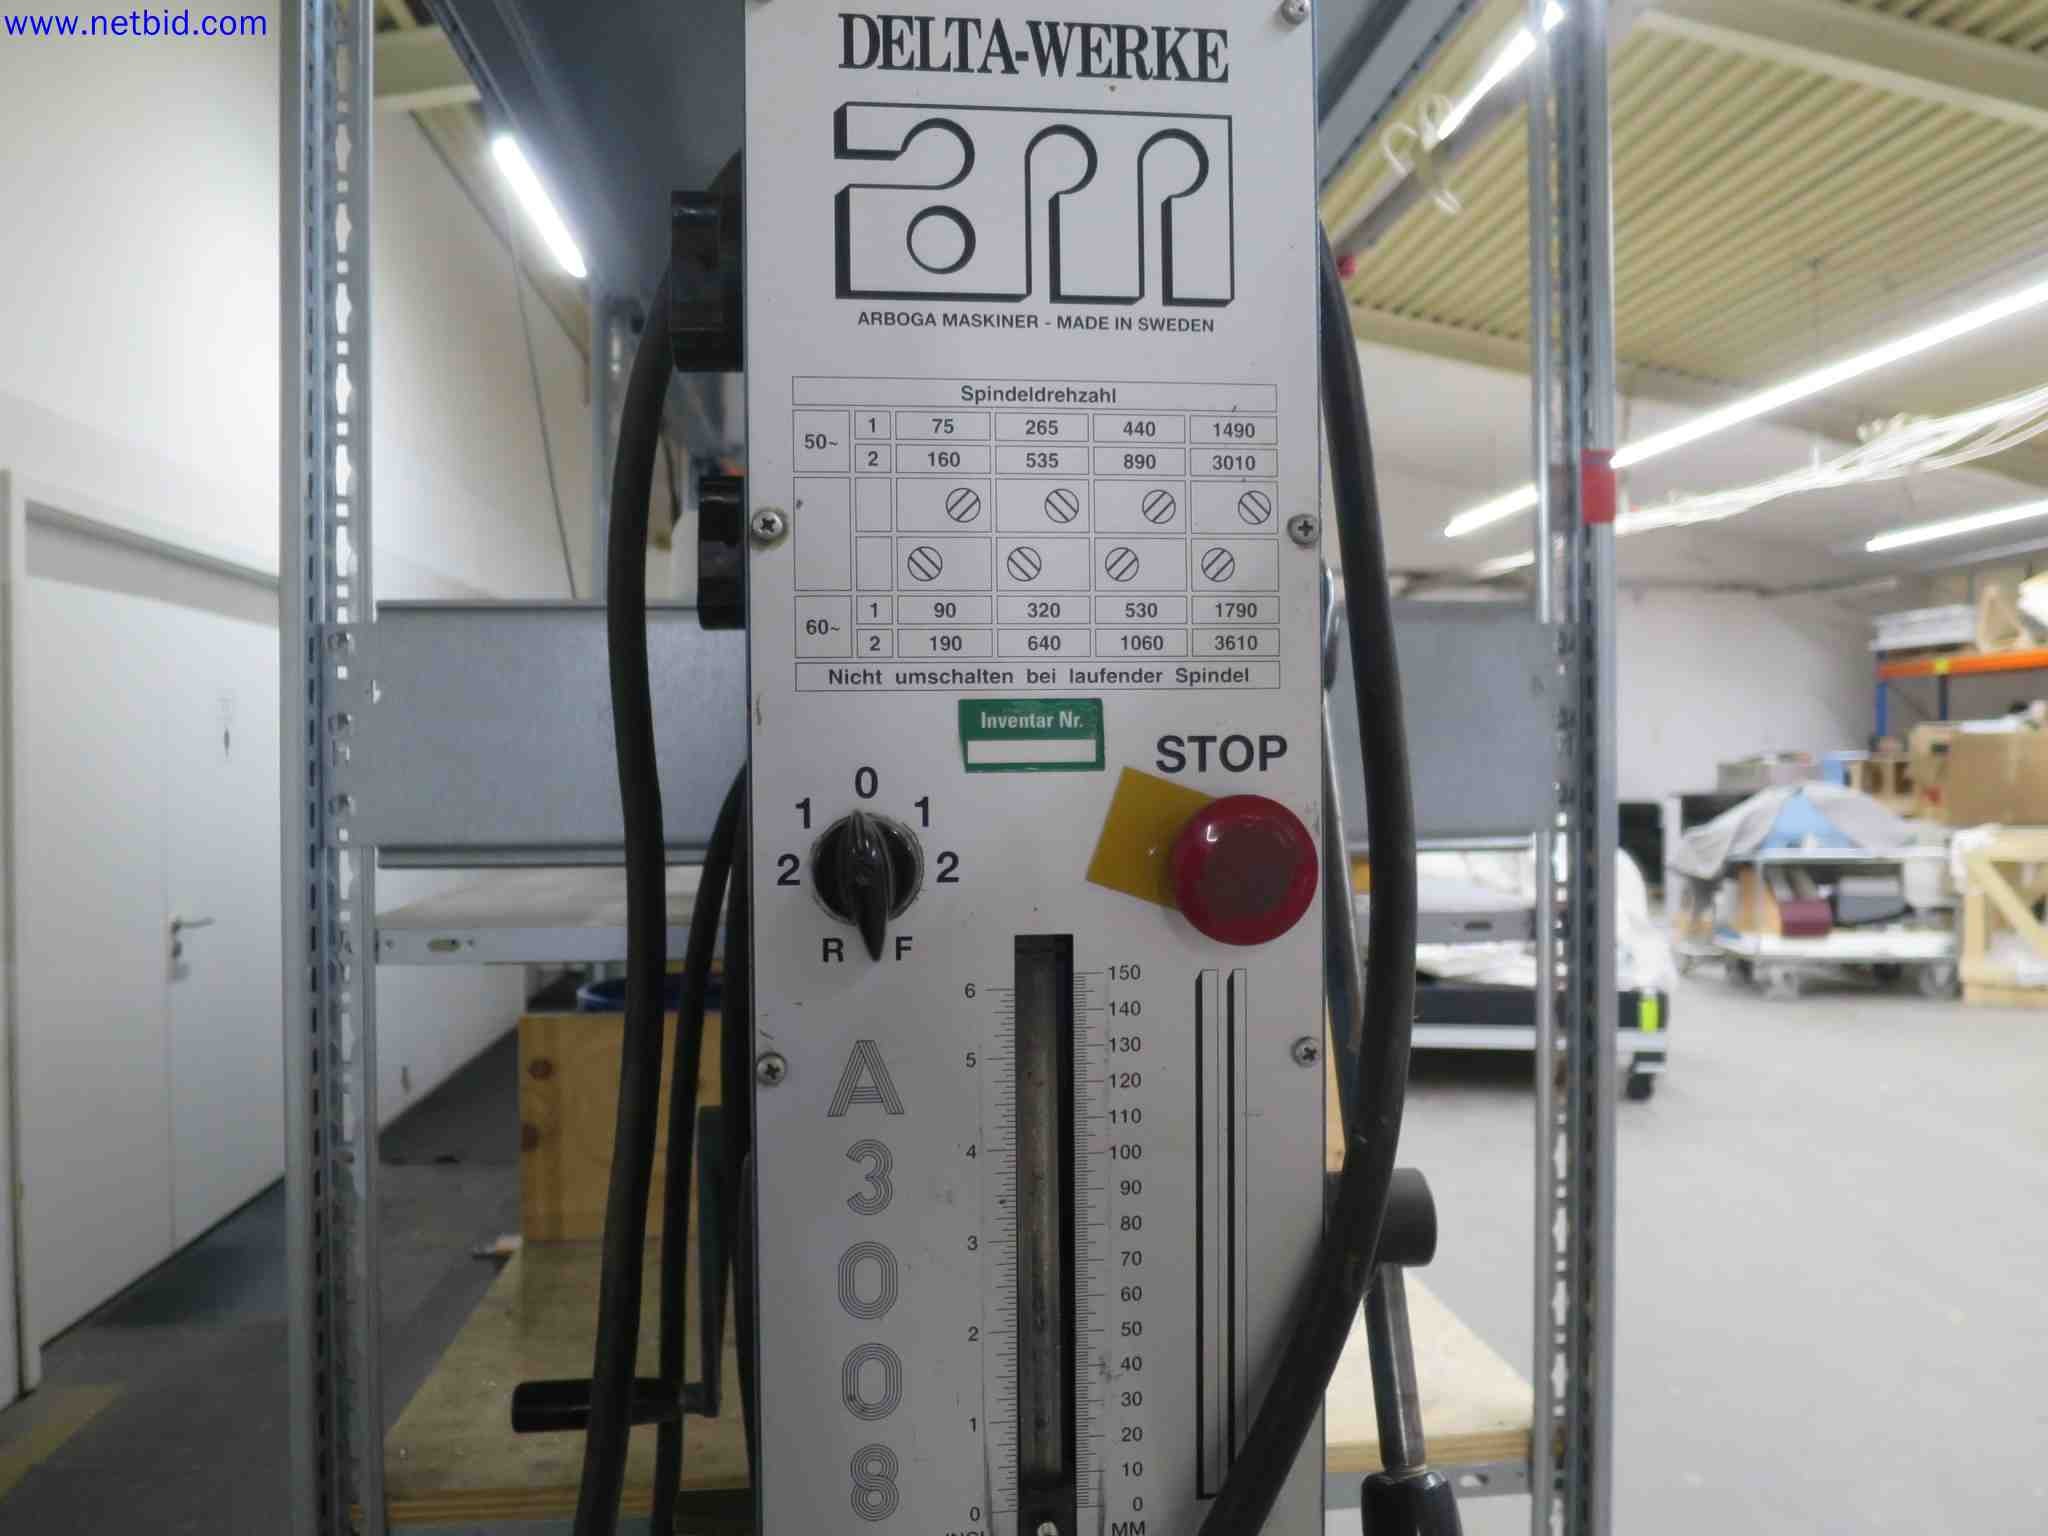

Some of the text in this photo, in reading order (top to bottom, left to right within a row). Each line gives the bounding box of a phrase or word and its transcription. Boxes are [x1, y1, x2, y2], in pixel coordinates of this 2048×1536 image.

[838, 13, 1228, 83] DELTA-WERKE
[857, 311, 937, 327] ARBOGA
[942, 312, 1039, 329] MASKINER
[1056, 315, 1110, 331] MADE
[1115, 316, 1133, 331] IN
[1138, 316, 1214, 333] SWEDEN
[960, 384, 1117, 406] Spindeldrehzahl
[867, 417, 1256, 439] 1 75 265 440 1490
[867, 450, 1257, 471] 2 160 535 890 3010
[869, 601, 1258, 619] 1 90 320 530 1790
[869, 634, 1259, 652] 2 190 640 1060 3610
[828, 666, 1249, 688] Nicht umschalten bei laufender Spindel
[981, 710, 1083, 729] Inventar Nr.
[1155, 735, 1287, 773] STOP
[854, 766, 879, 800] 0
[795, 797, 811, 830] 1
[914, 795, 929, 828] 1
[776, 853, 801, 887] 2
[935, 850, 960, 884] 2
[822, 937, 844, 963] R
[895, 935, 913, 961] F
[1107, 963, 1141, 981] 150
[964, 982, 976, 999] 6
[1108, 1000, 1142, 1017] 140
[1108, 1036, 1141, 1053] 130
[965, 1051, 977, 1069] 5
[1109, 1072, 1142, 1089] 120
[1108, 1108, 1142, 1125] 110
[965, 1143, 977, 1160] 4
[1108, 1143, 1143, 1161] 100
[1119, 1179, 1143, 1196] 90
[1119, 1215, 1143, 1232] 80
[967, 1234, 979, 1252] 3
[1120, 1250, 1143, 1267] 70
[1120, 1285, 1143, 1302] 60
[967, 1325, 979, 1342] 2
[1120, 1320, 1143, 1337] 50
[1119, 1355, 1143, 1372] 40
[1120, 1391, 1143, 1408] 30
[969, 1417, 977, 1433] 1
[1121, 1426, 1143, 1443] 20
[1122, 1461, 1143, 1477] 10
[1132, 1496, 1144, 1513] 0
[969, 1506, 981, 1522] 0
[1111, 1520, 1146, 1536] MM
